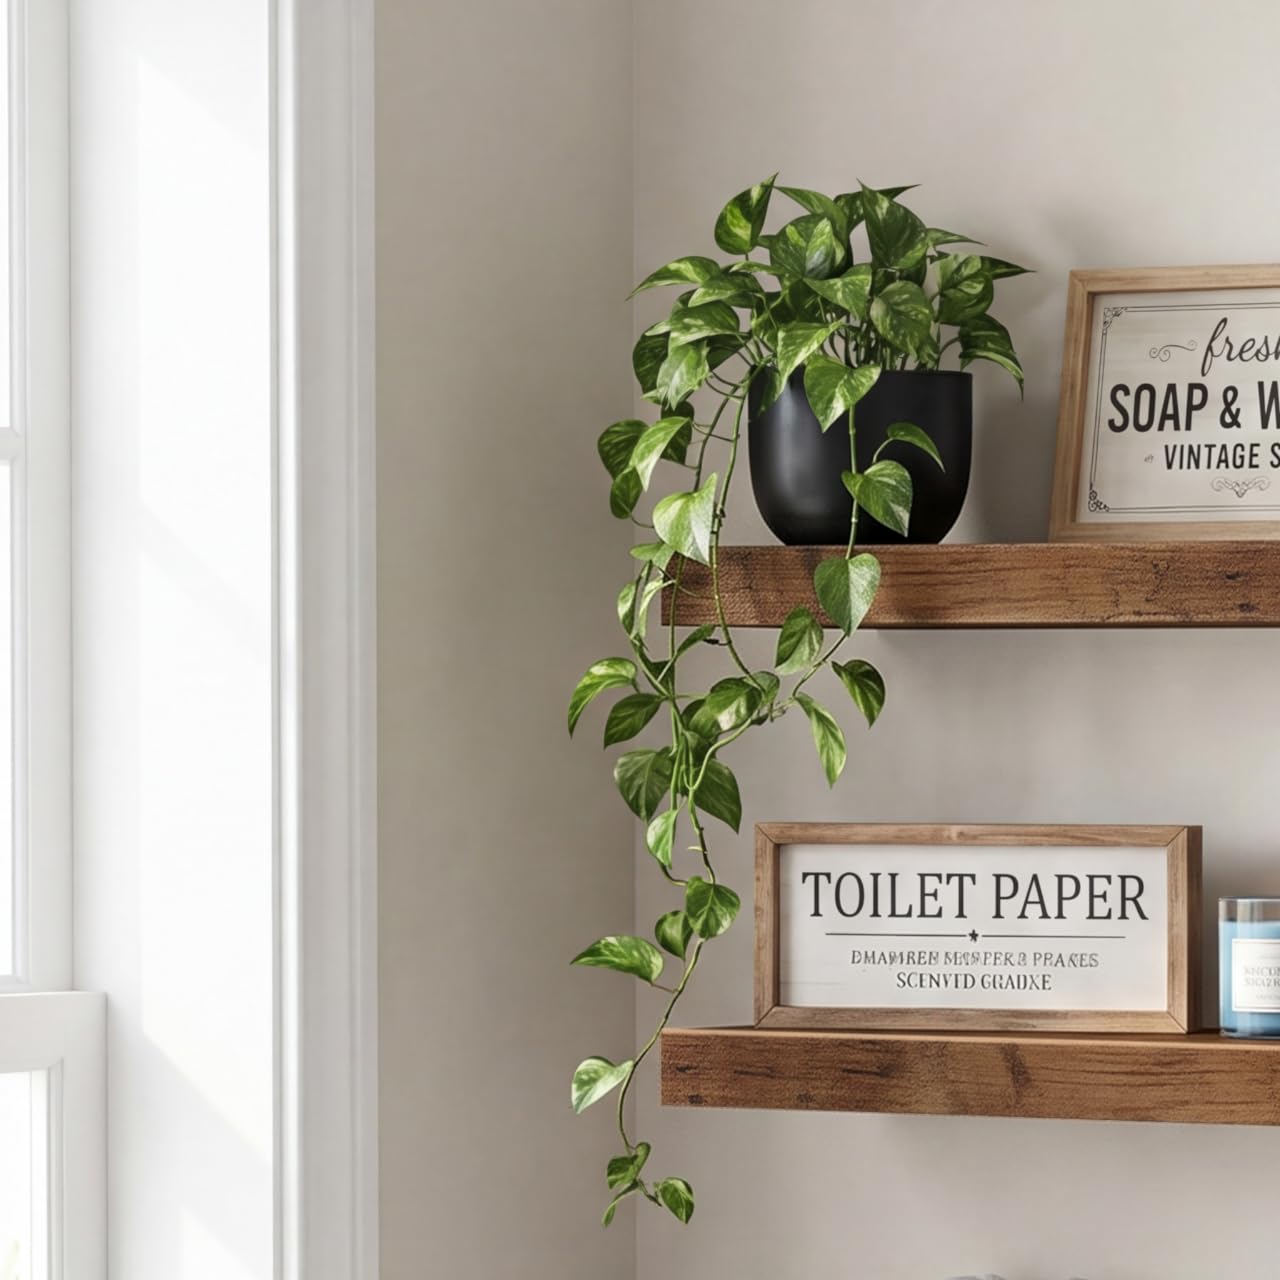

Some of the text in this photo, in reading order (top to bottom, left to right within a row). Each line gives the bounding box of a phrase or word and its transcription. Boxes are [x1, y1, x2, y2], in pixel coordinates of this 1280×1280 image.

[1108, 383, 1208, 432] SOAP
[1220, 386, 1241, 428] &
[1165, 443, 1260, 470] VINTAGE
[802, 872, 1149, 920] TOILET PAPER
